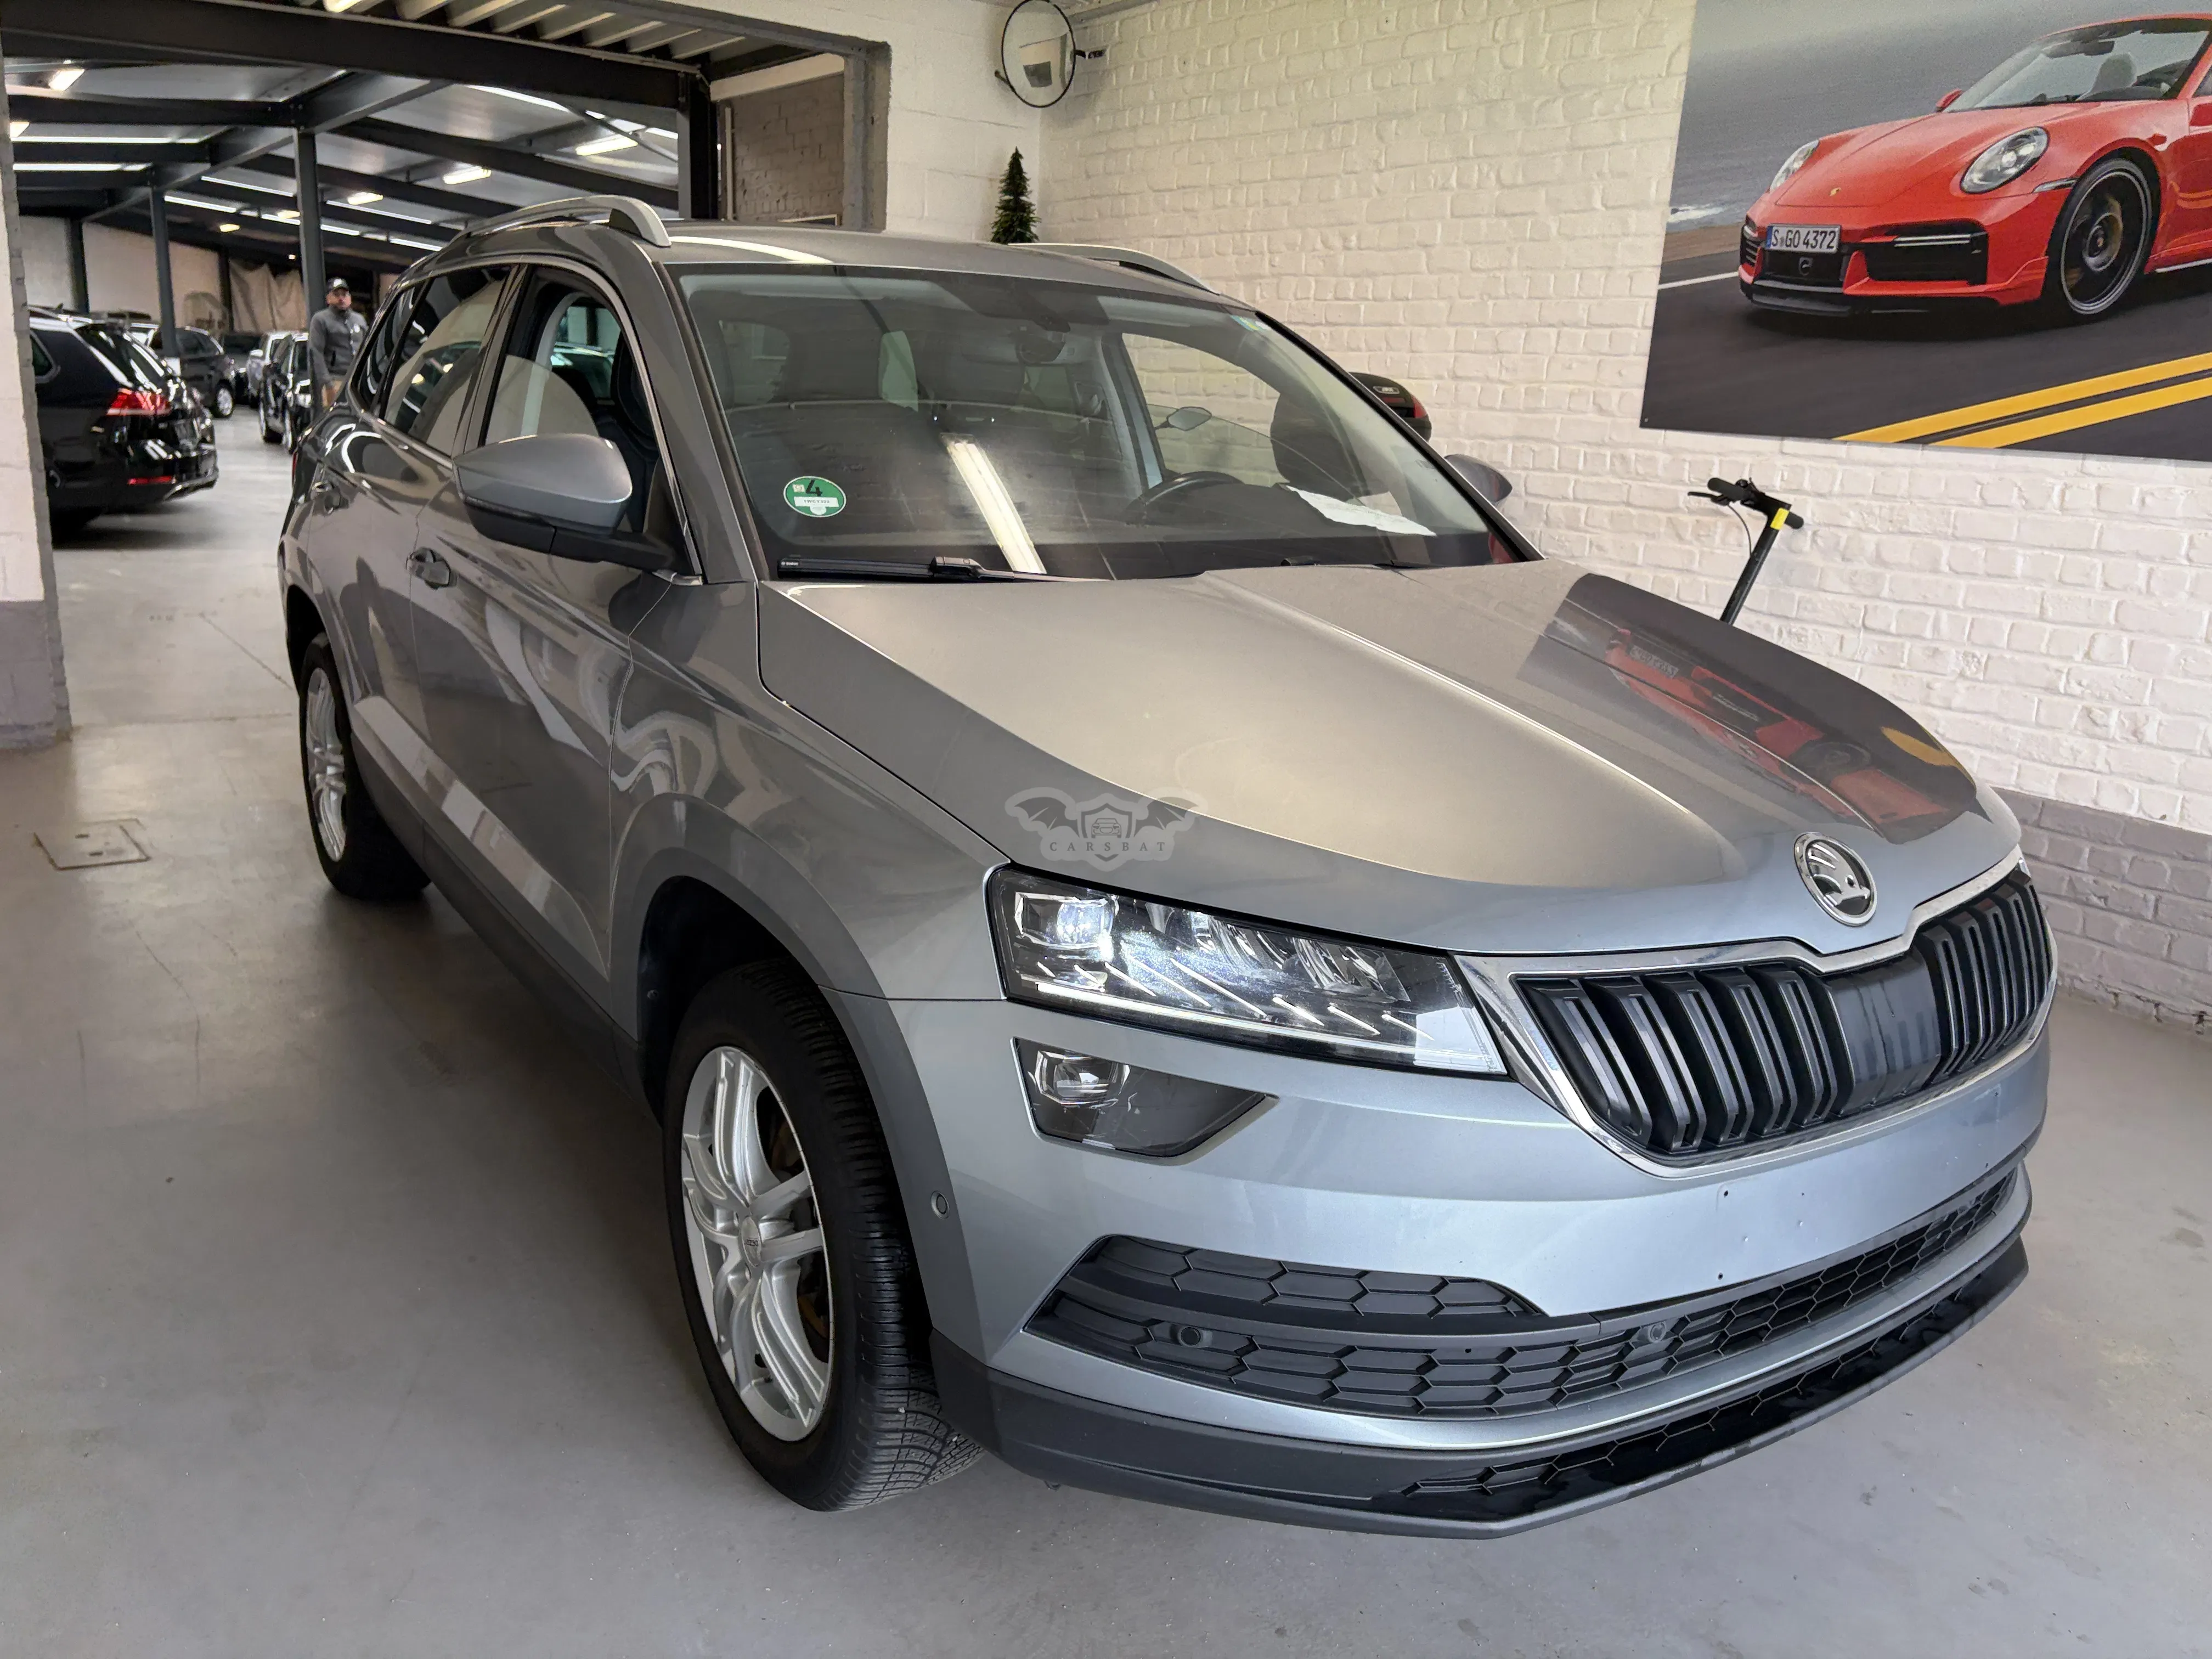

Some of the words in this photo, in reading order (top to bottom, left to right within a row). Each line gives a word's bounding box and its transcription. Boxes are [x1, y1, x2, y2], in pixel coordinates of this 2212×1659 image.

[1771, 229, 1779, 246] S
[1785, 229, 1801, 249] GO
[1803, 230, 1837, 250] 4372
[806, 478, 822, 496] 4
